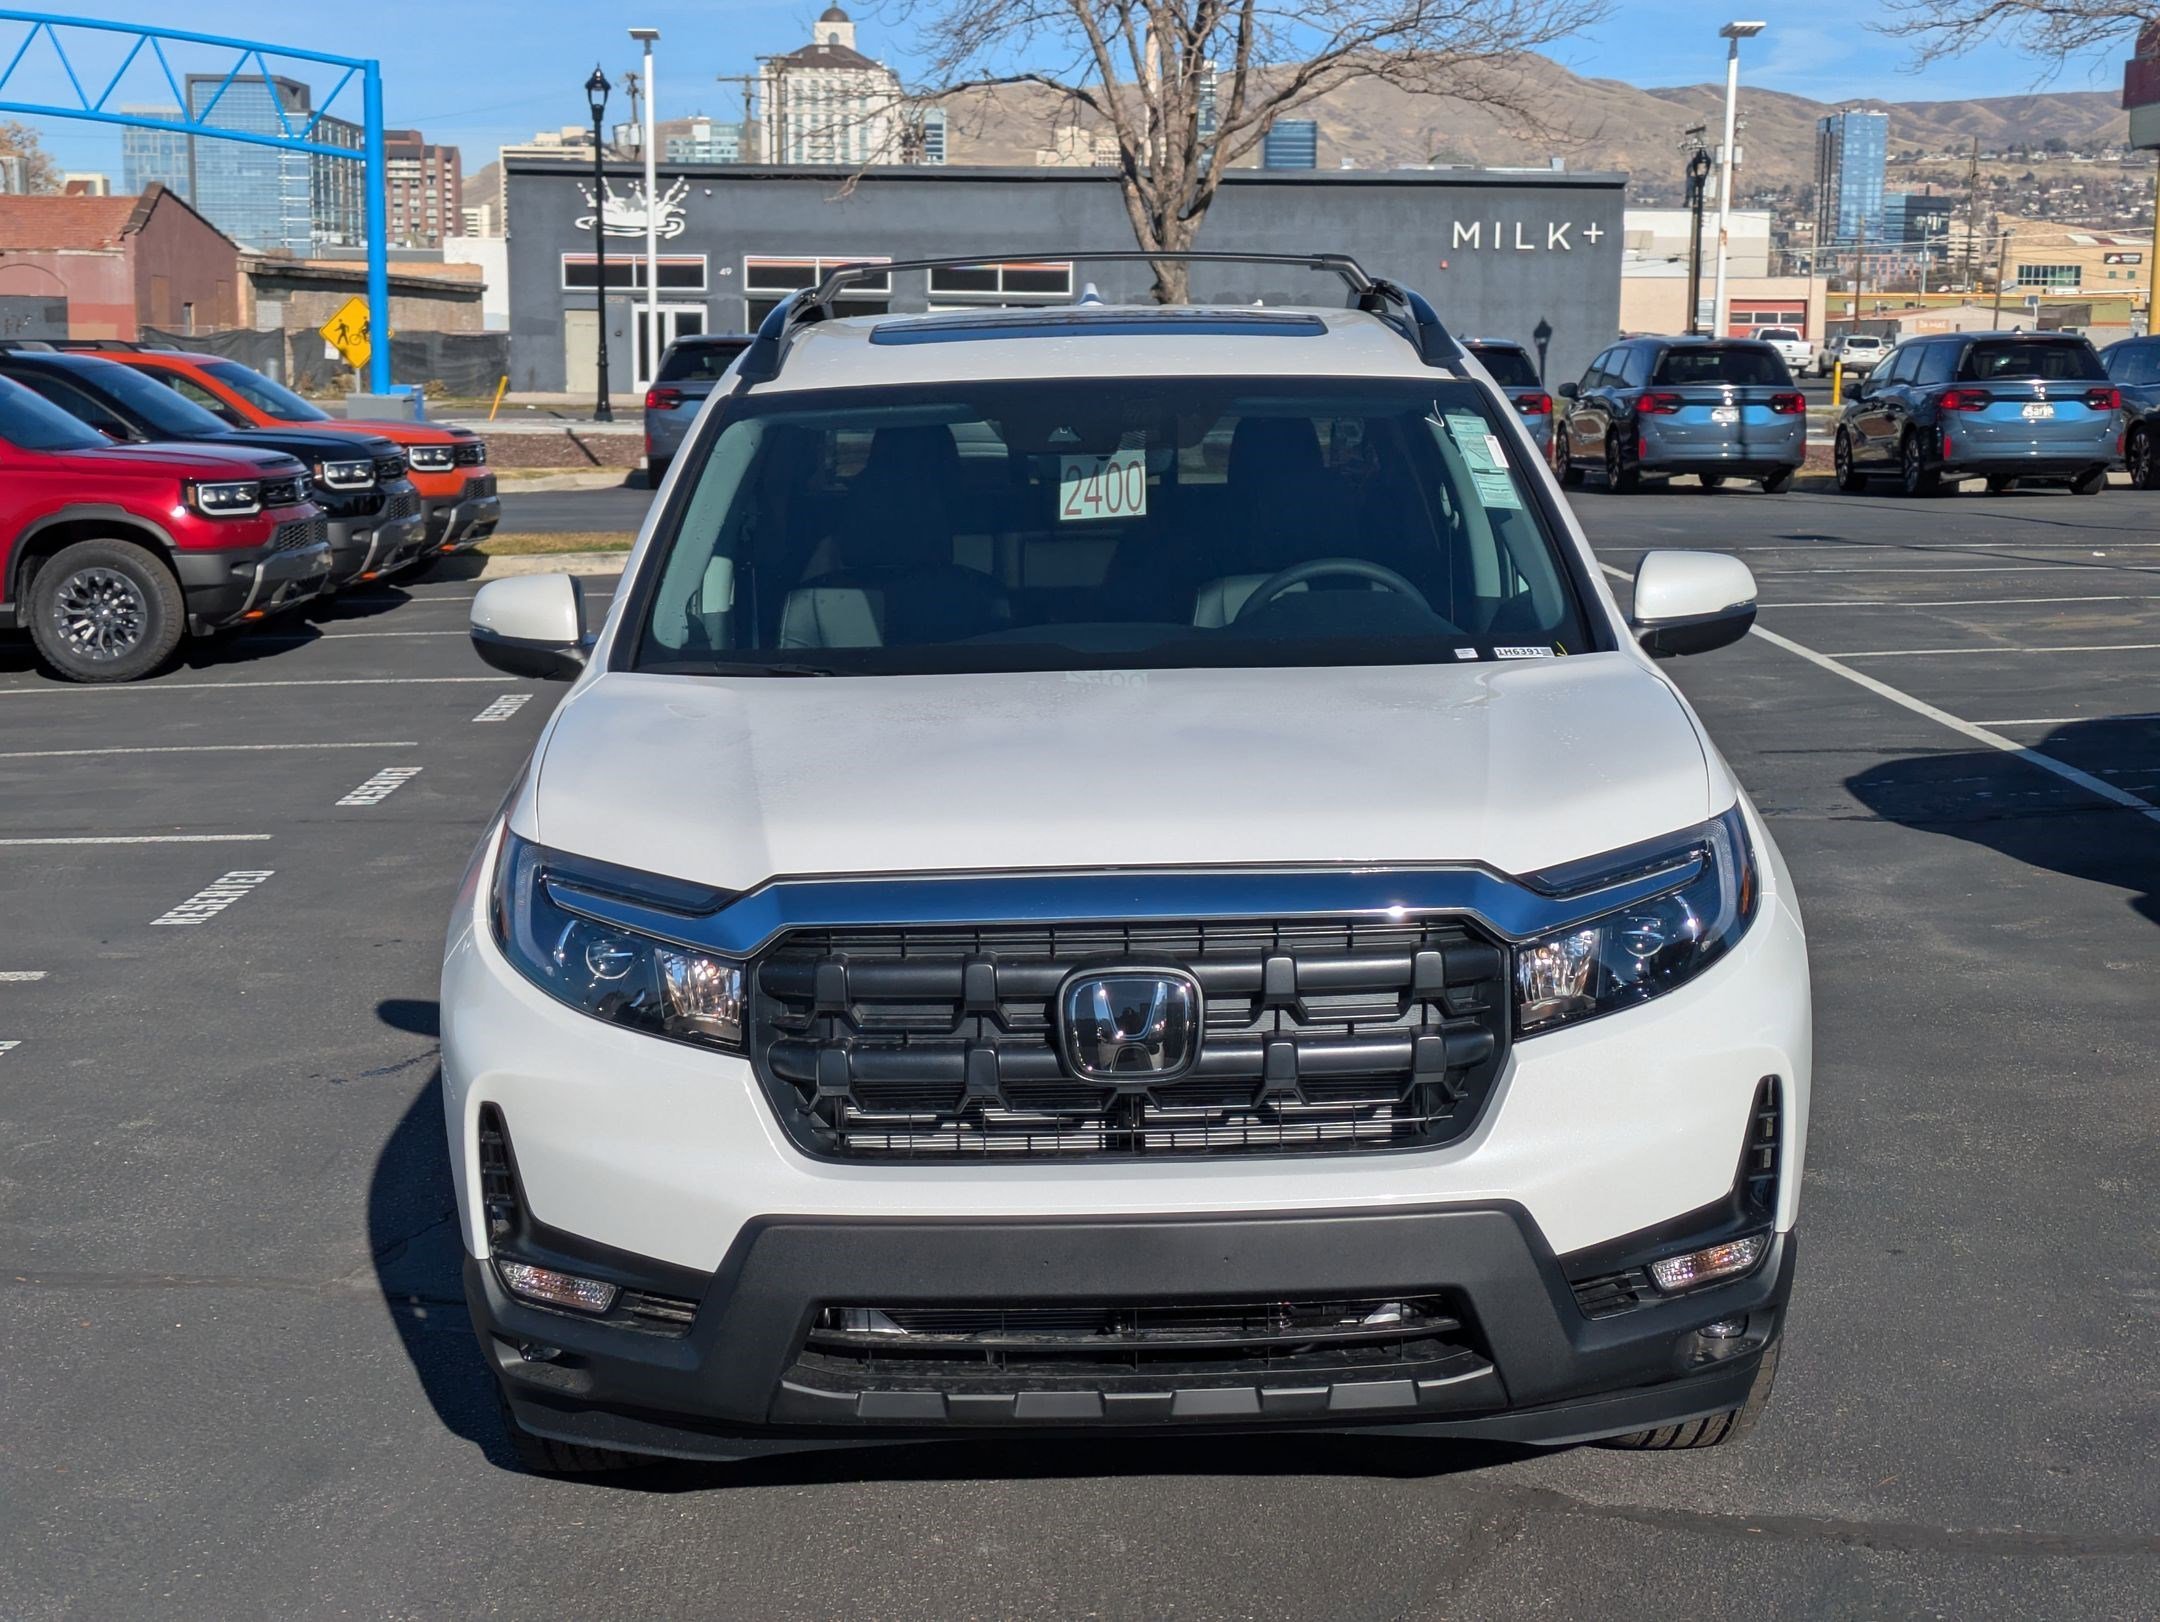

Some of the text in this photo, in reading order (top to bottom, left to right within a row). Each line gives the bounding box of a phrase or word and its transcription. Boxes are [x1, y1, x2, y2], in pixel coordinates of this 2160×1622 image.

[1452, 221, 1605, 251] MILK+
[1063, 460, 1144, 516] 2400
[149, 870, 276, 925] RESERVED
